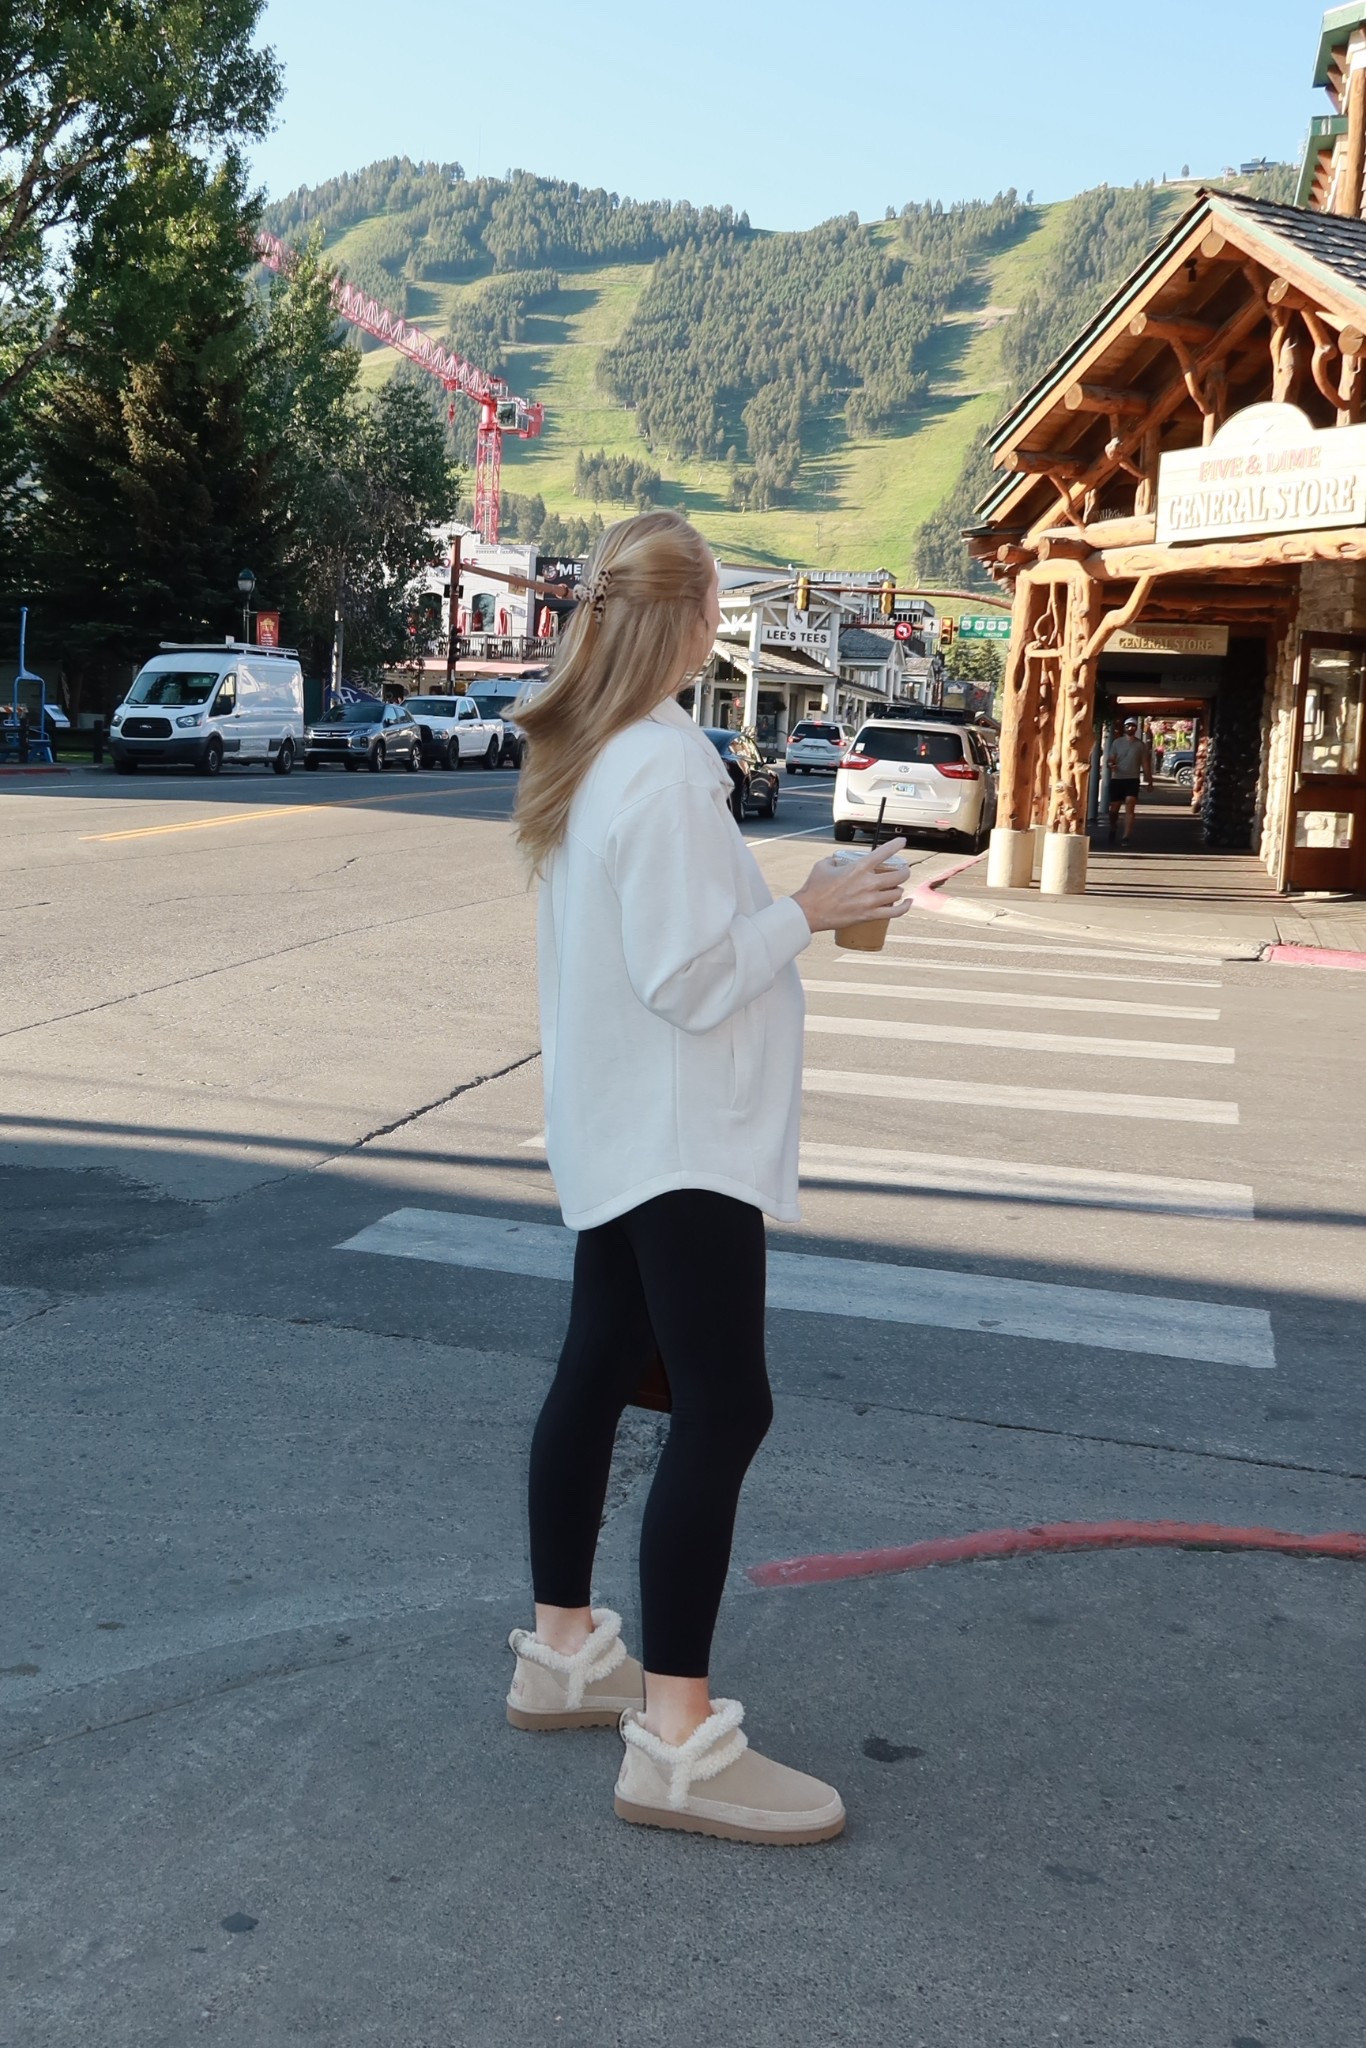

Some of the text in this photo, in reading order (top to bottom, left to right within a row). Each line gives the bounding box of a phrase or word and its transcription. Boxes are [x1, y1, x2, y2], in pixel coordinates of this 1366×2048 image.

[1199, 446, 1322, 483] FIVE & DIME
[1169, 474, 1357, 530] GENERAL STORE
[559, 563, 585, 577] ME
[766, 629, 827, 644] LEE'S TEES
[1119, 637, 1212, 651] GENERAL STORE
